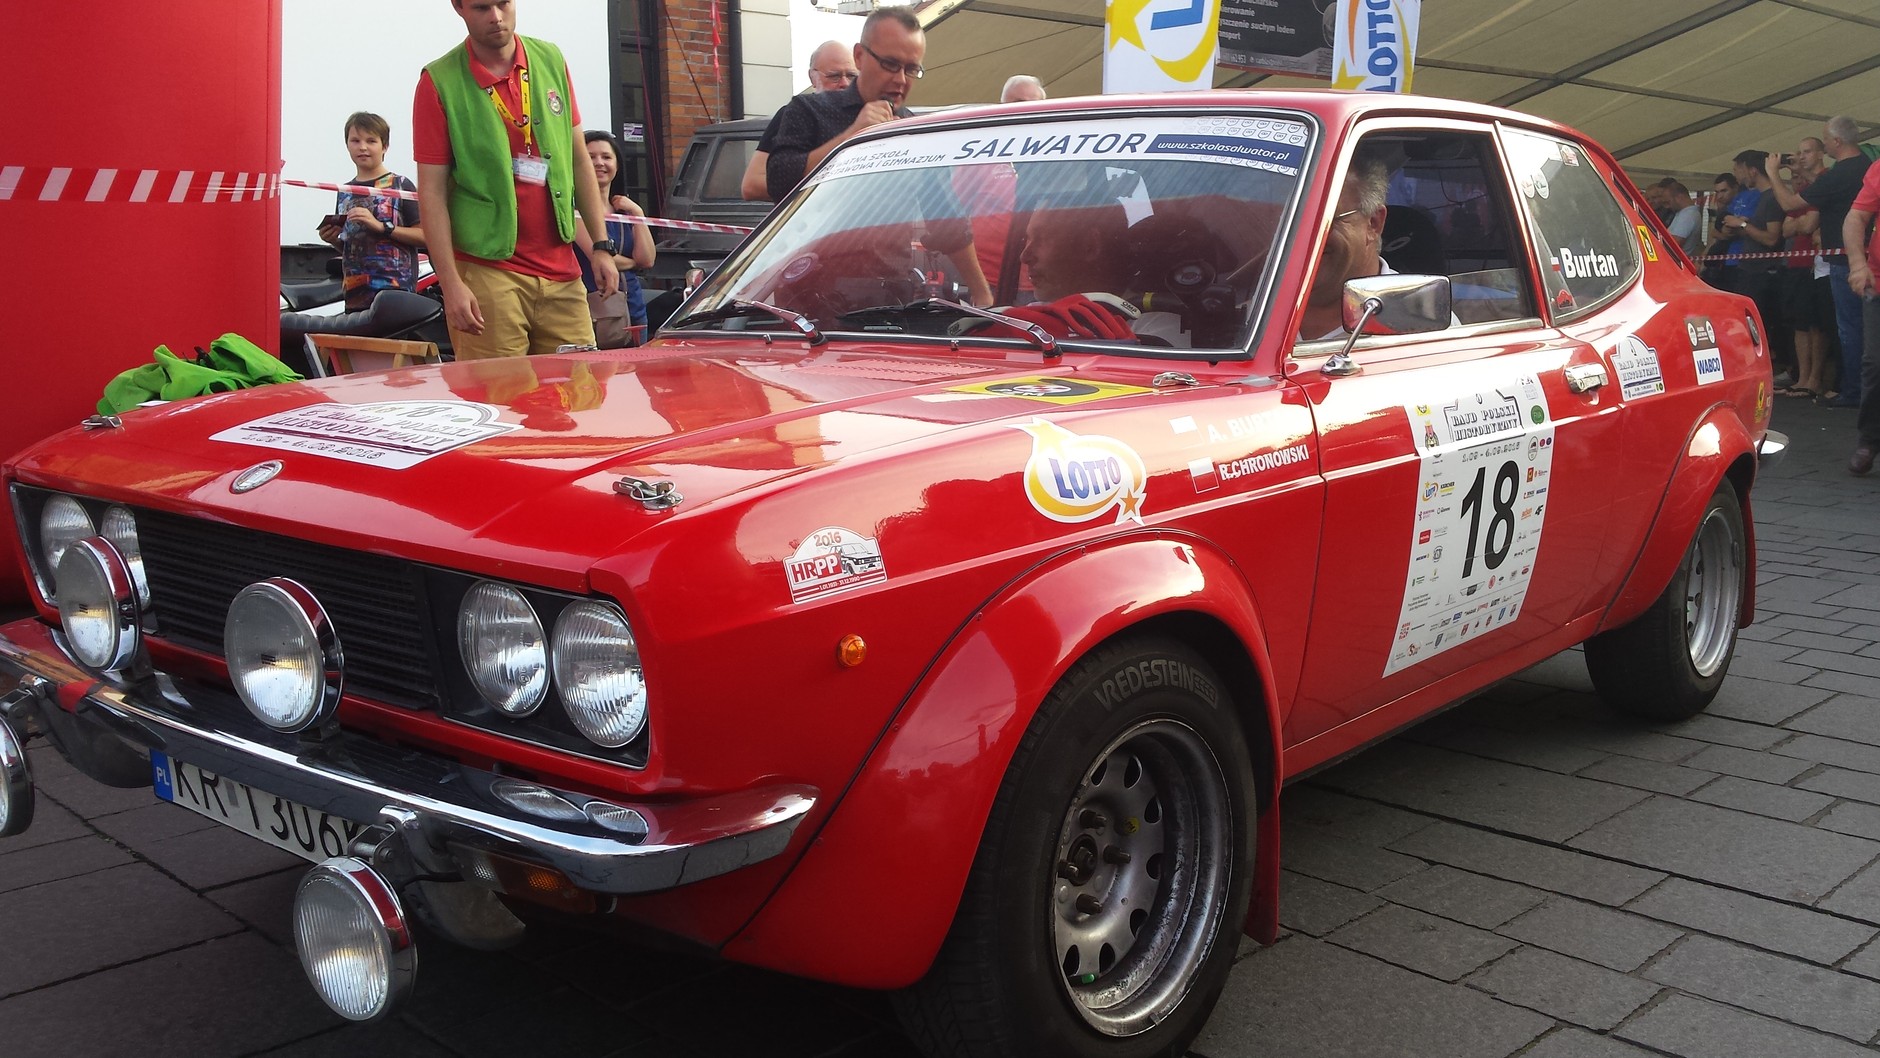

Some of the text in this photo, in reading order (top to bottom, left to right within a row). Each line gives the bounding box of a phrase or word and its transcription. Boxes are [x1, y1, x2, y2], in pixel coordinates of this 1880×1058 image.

[1250, 22, 1276, 33] suchym
[1276, 24, 1296, 35] lodem
[868, 149, 910, 162] SZKOŁA
[953, 133, 1147, 160] SALWATOR
[1157, 141, 1290, 161] www.szkolasalwator.pl
[881, 154, 947, 168] GIMNAZJUM
[1559, 247, 1620, 279] Burtan
[1696, 357, 1721, 375] WABCO
[318, 410, 384, 424] RAJD
[1451, 410, 1478, 427] RAJD
[1481, 404, 1516, 421] POLSKI
[1048, 456, 1122, 500] LOTTO
[1460, 460, 1520, 579] 18
[813, 532, 842, 547] 2016
[791, 554, 839, 584] HRPP
[1093, 659, 1196, 712] VREDESTEIN
[156, 766, 170, 787] PL
[173, 758, 228, 818] KR
